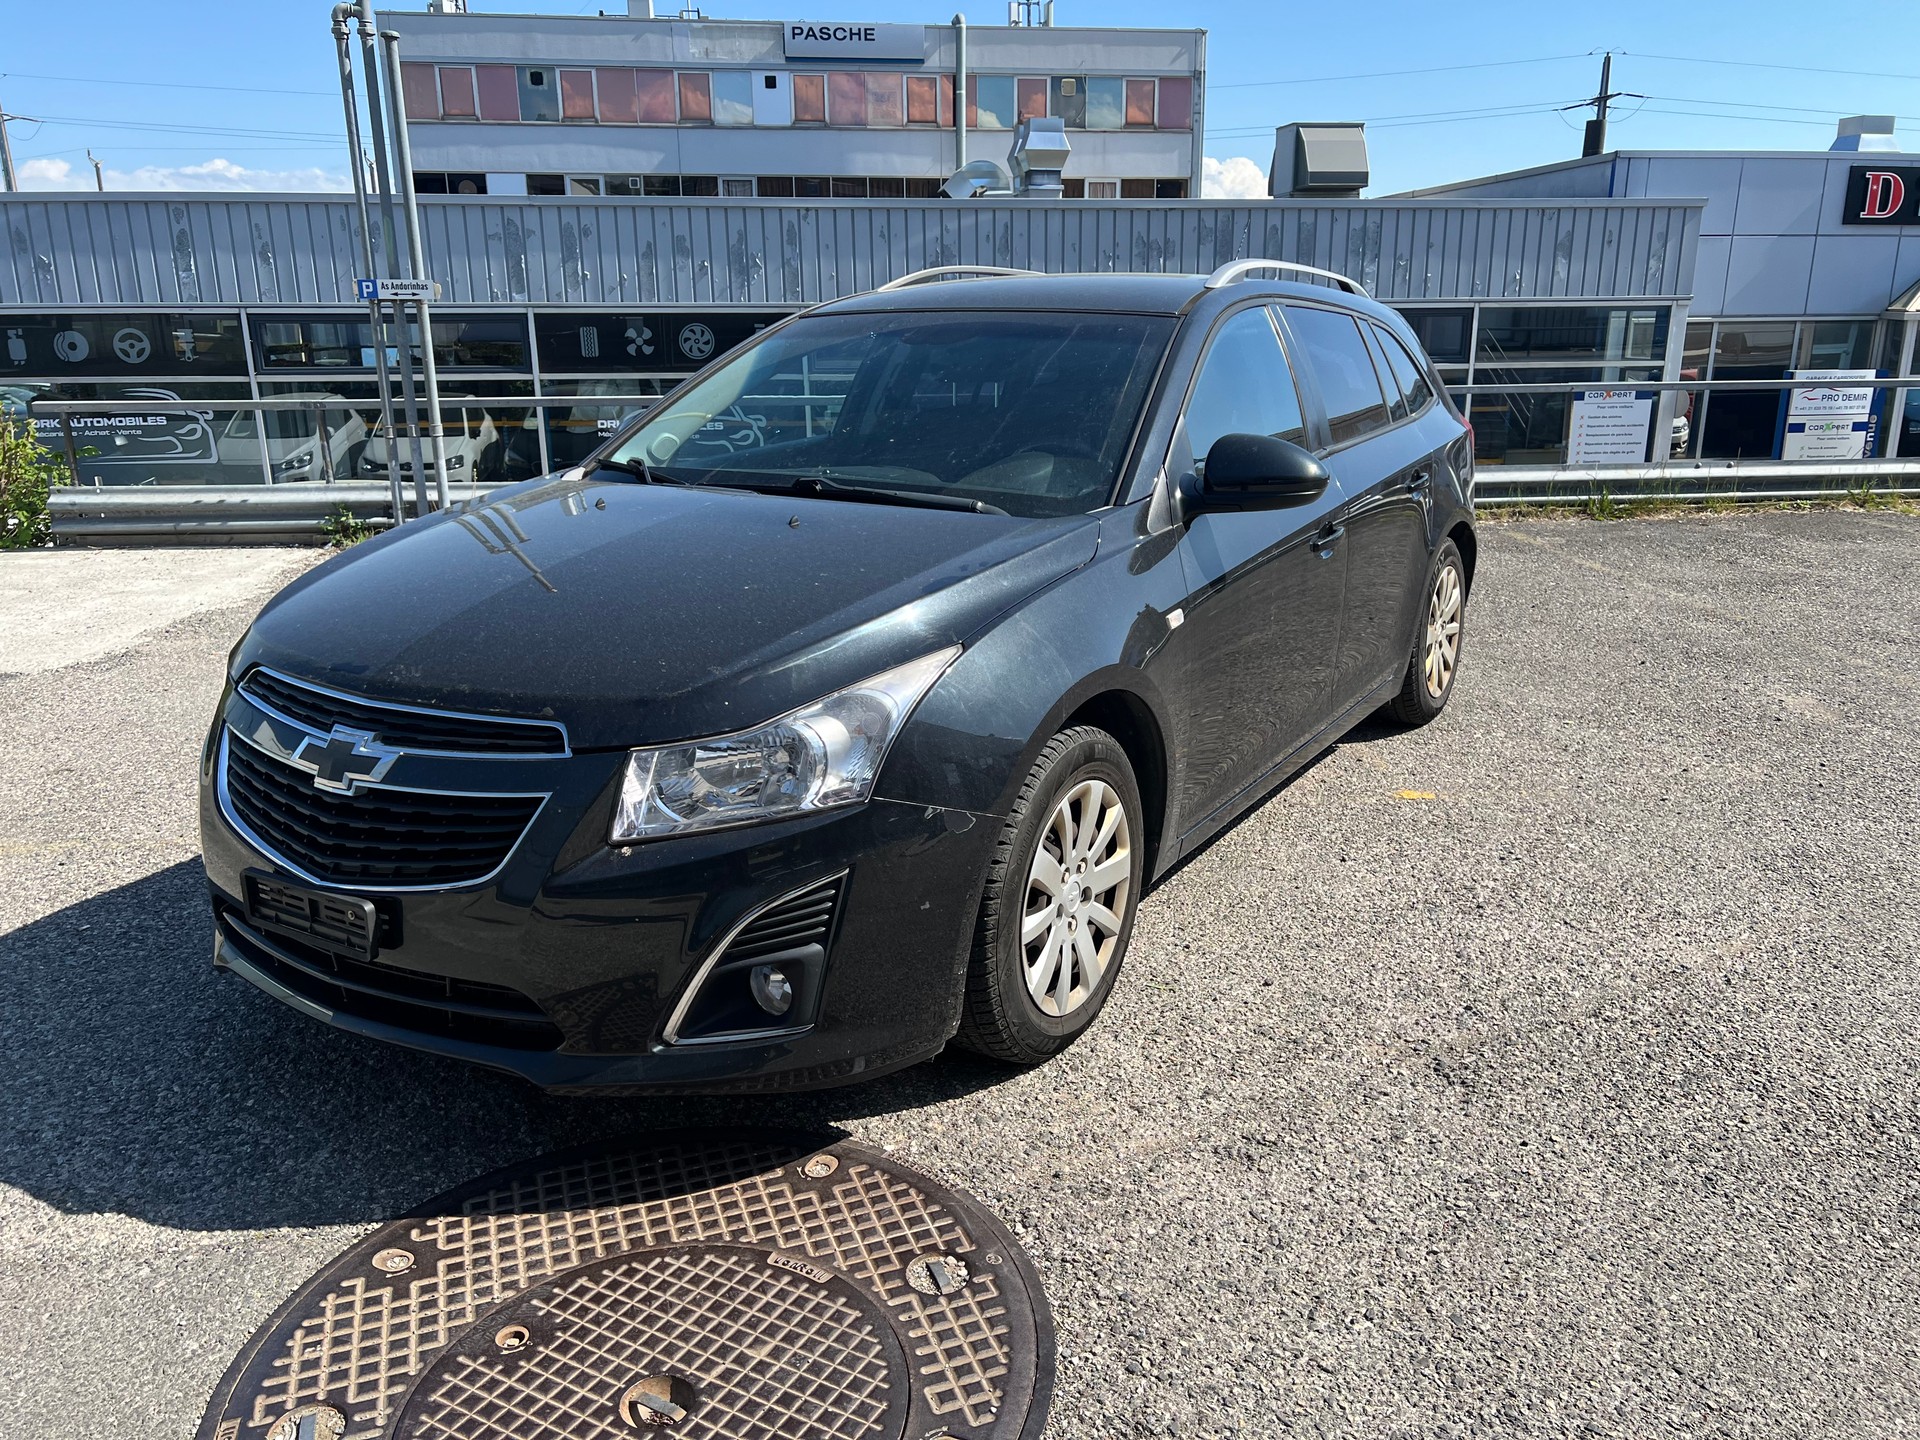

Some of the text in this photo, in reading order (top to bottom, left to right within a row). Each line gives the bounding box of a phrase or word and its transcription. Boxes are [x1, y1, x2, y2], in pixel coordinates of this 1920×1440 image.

[791, 26, 876, 42] PASCHE
[1860, 171, 1905, 218] D
[362, 281, 373, 297] P
[381, 282, 429, 291] As Andorinhas
[1820, 393, 1868, 402] PRO DEMIR
